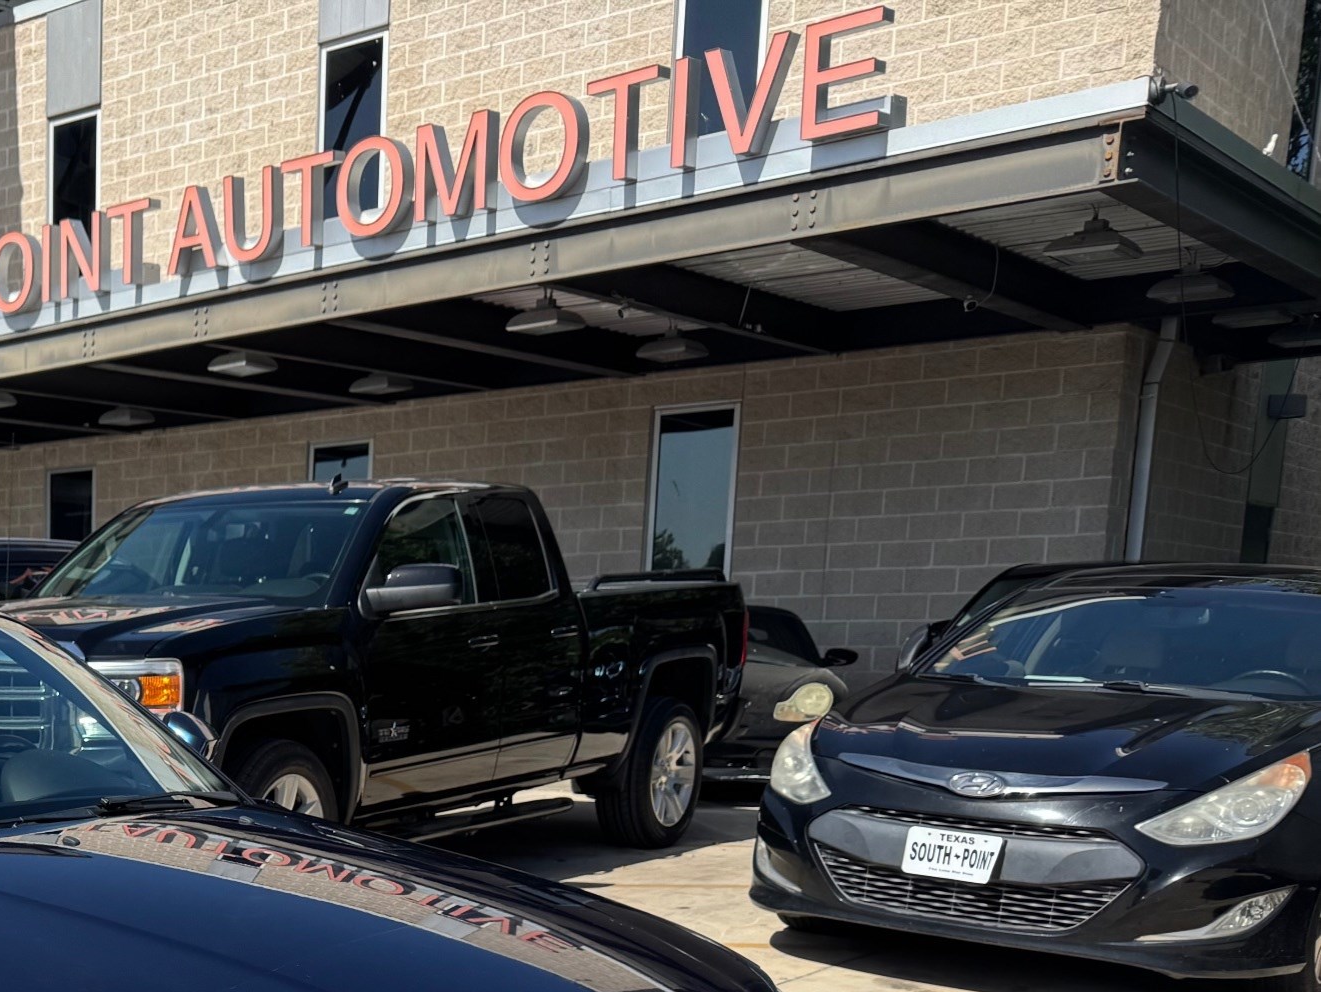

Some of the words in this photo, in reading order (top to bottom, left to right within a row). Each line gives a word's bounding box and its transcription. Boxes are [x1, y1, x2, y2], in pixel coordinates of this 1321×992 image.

[167, 6, 894, 275] AUTOMOTIVE
[939, 833, 975, 845] TEXAS
[909, 841, 953, 866] SOUTH
[961, 847, 995, 871] POINT
